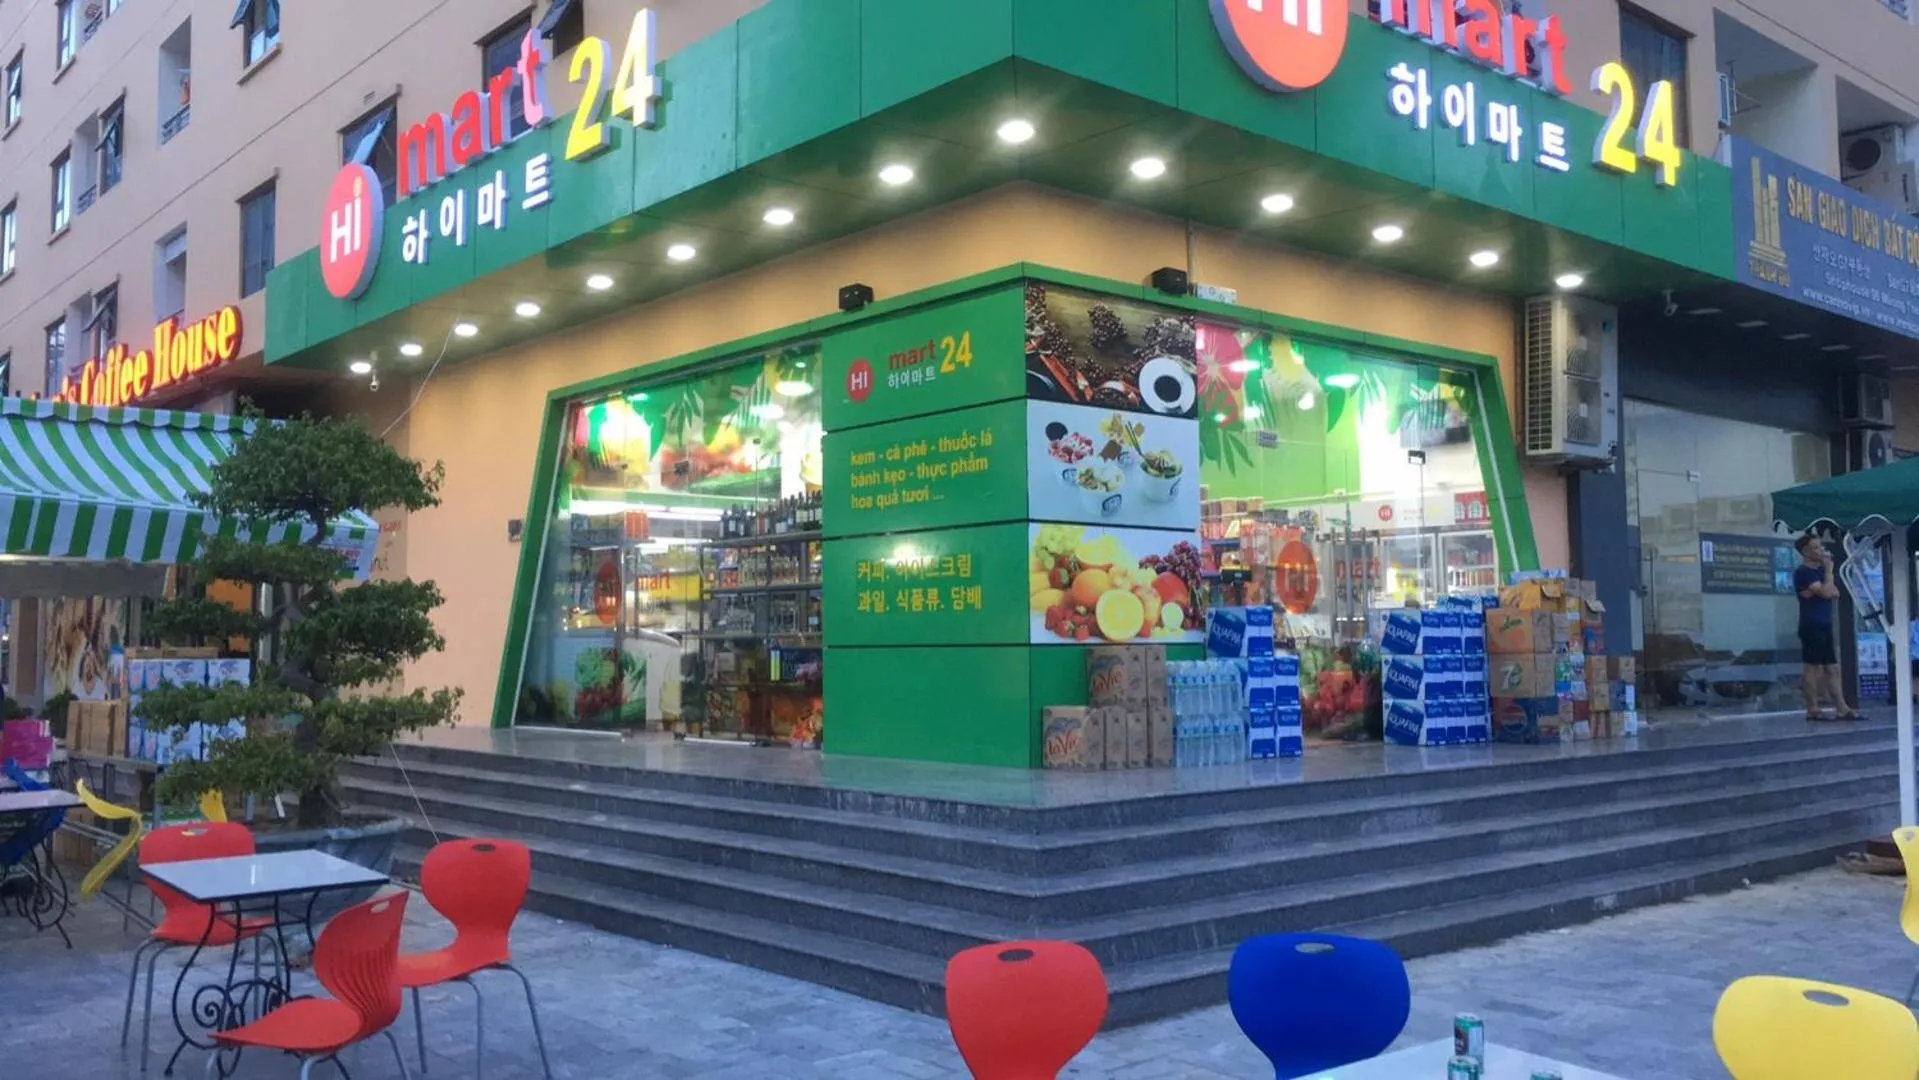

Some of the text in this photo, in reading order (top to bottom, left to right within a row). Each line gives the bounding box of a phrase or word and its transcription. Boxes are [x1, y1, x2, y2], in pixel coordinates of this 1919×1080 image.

[330, 8, 660, 263] Hi mart 24
[1389, 62, 1569, 172] 하이마트
[1594, 62, 1681, 187] 24
[402, 153, 552, 264] 하이마트
[81, 305, 240, 406] Coffee House
[888, 340, 936, 370] mart
[940, 331, 972, 373] 24
[888, 366, 936, 389] 하이마트
[851, 451, 876, 465] kem
[851, 468, 880, 488] bánh
[851, 495, 873, 509] hoa
[951, 585, 982, 610] 담배
